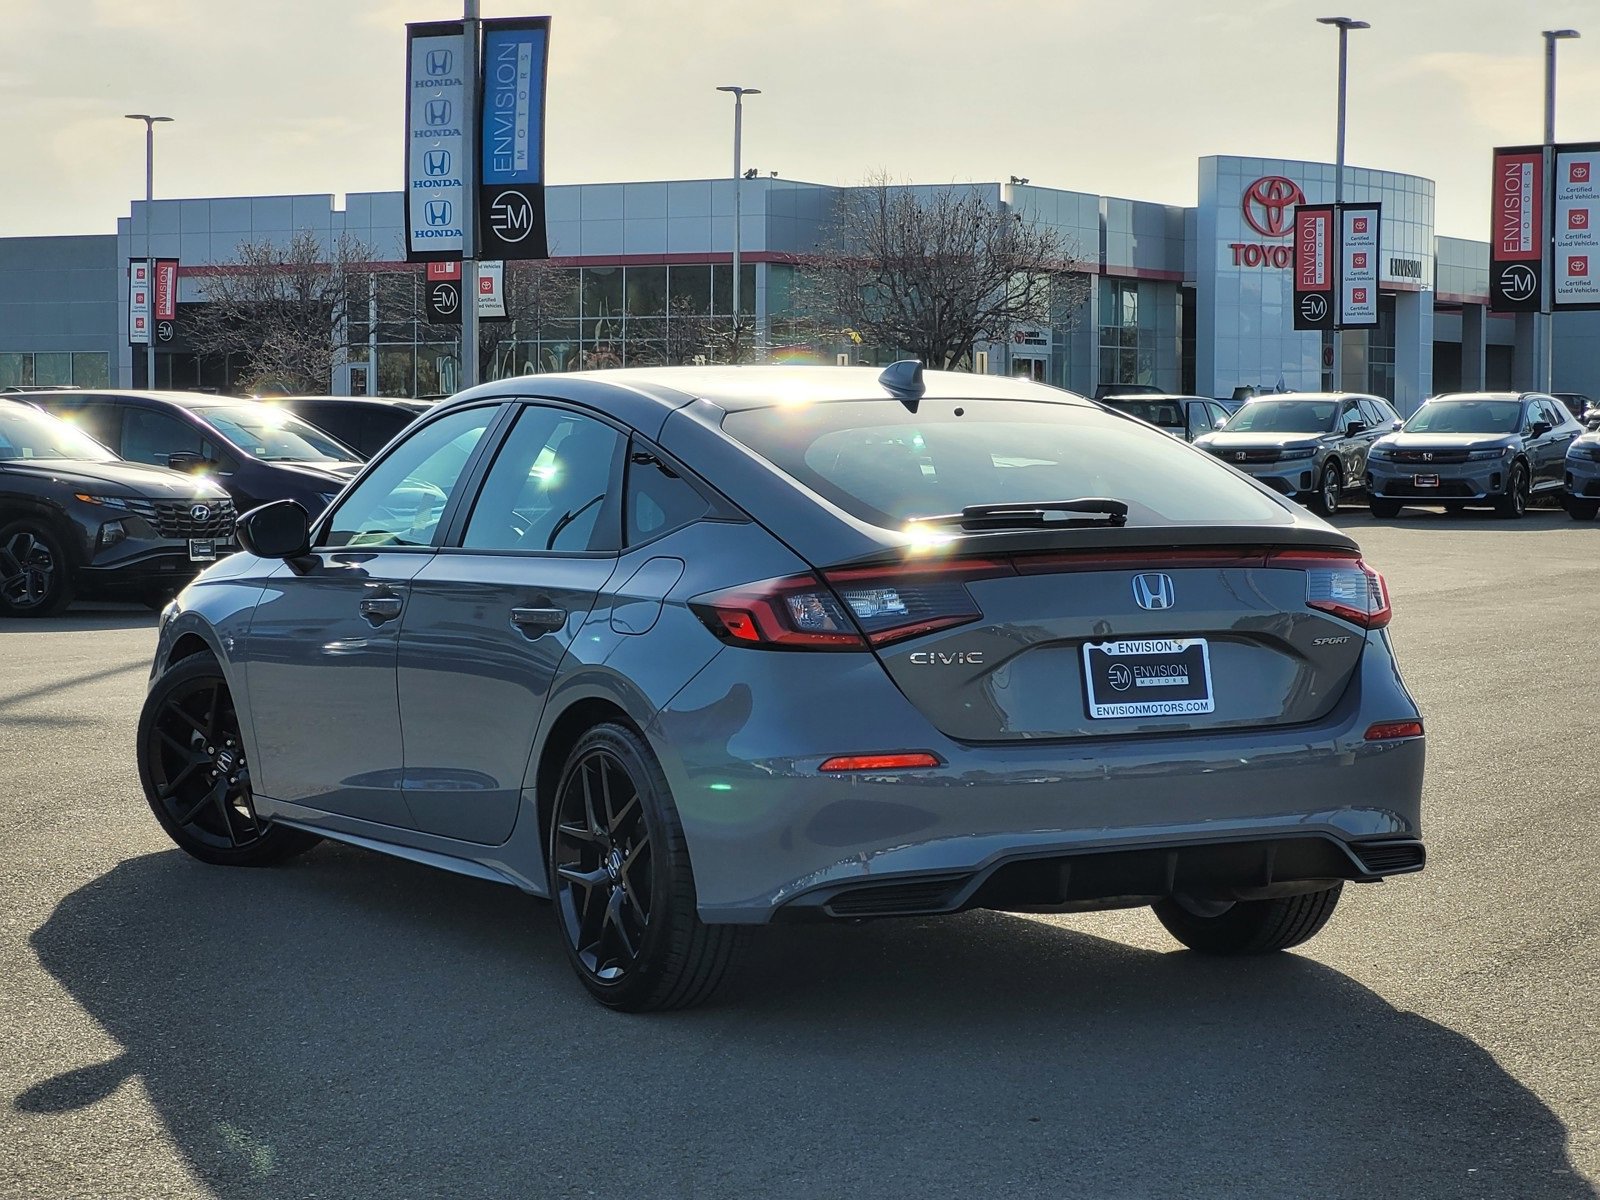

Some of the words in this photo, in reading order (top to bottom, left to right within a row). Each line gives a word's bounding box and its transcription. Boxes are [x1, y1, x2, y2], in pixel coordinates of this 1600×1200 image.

[414, 78, 463, 88] HONDA
[494, 43, 517, 172] ENVISION
[517, 53, 529, 160] MOTORS
[414, 128, 462, 138] HONDA
[413, 179, 463, 188] HONDA
[1504, 163, 1521, 253] ENVISION
[1523, 170, 1531, 244] MOTORS
[414, 229, 463, 238] HONDA
[1230, 243, 1294, 268] TOYO
[1303, 217, 1316, 285] ENVISION
[1390, 258, 1421, 278] ENVISION
[160, 266, 168, 315] ENVISION
[1117, 641, 1173, 654] ENVISION
[1312, 636, 1351, 646] SPORT
[909, 652, 984, 665] CIVIC
[1133, 664, 1189, 678] ENVISION
[1096, 702, 1209, 716] ENVISIONMOTORS.COM
